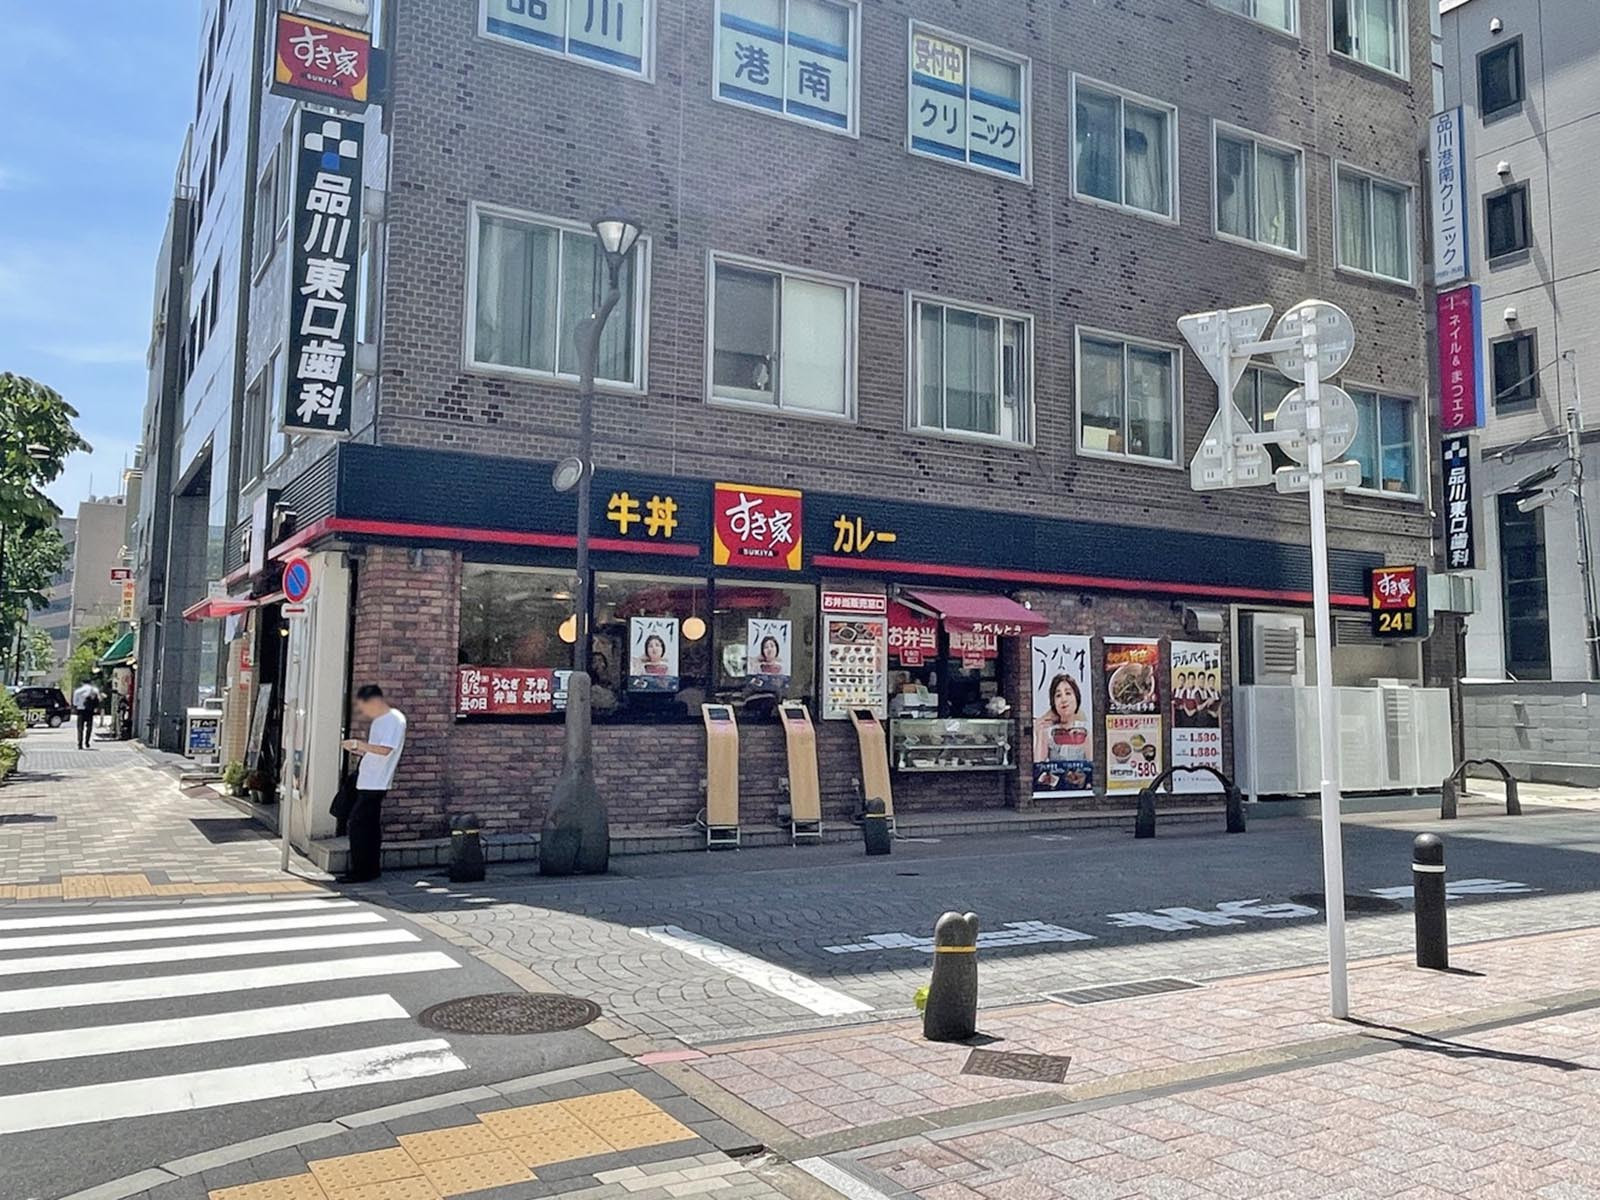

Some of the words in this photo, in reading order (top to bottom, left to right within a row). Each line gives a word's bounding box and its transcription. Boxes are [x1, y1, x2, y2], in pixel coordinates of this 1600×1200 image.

[289, 26, 359, 78] すき家
[734, 41, 831, 102] 港南
[914, 38, 963, 81] 受付中
[306, 73, 338, 87] SUKIYA
[919, 98, 1017, 148] クリニック
[1436, 114, 1457, 266] 品川港南クリニック
[296, 172, 353, 426] 品川東口歯科
[607, 491, 679, 538] 牛丼
[725, 492, 793, 548] すき家
[833, 514, 897, 553] カレー
[1448, 466, 1470, 567] 品川東口歯科
[742, 548, 774, 557] SUKIYA
[1377, 573, 1411, 598] すき家
[888, 626, 937, 649] お弁当
[1173, 650, 1209, 669] アルバイト
[460, 697, 487, 711] 丑の日
[492, 677, 520, 691] うなぎ
